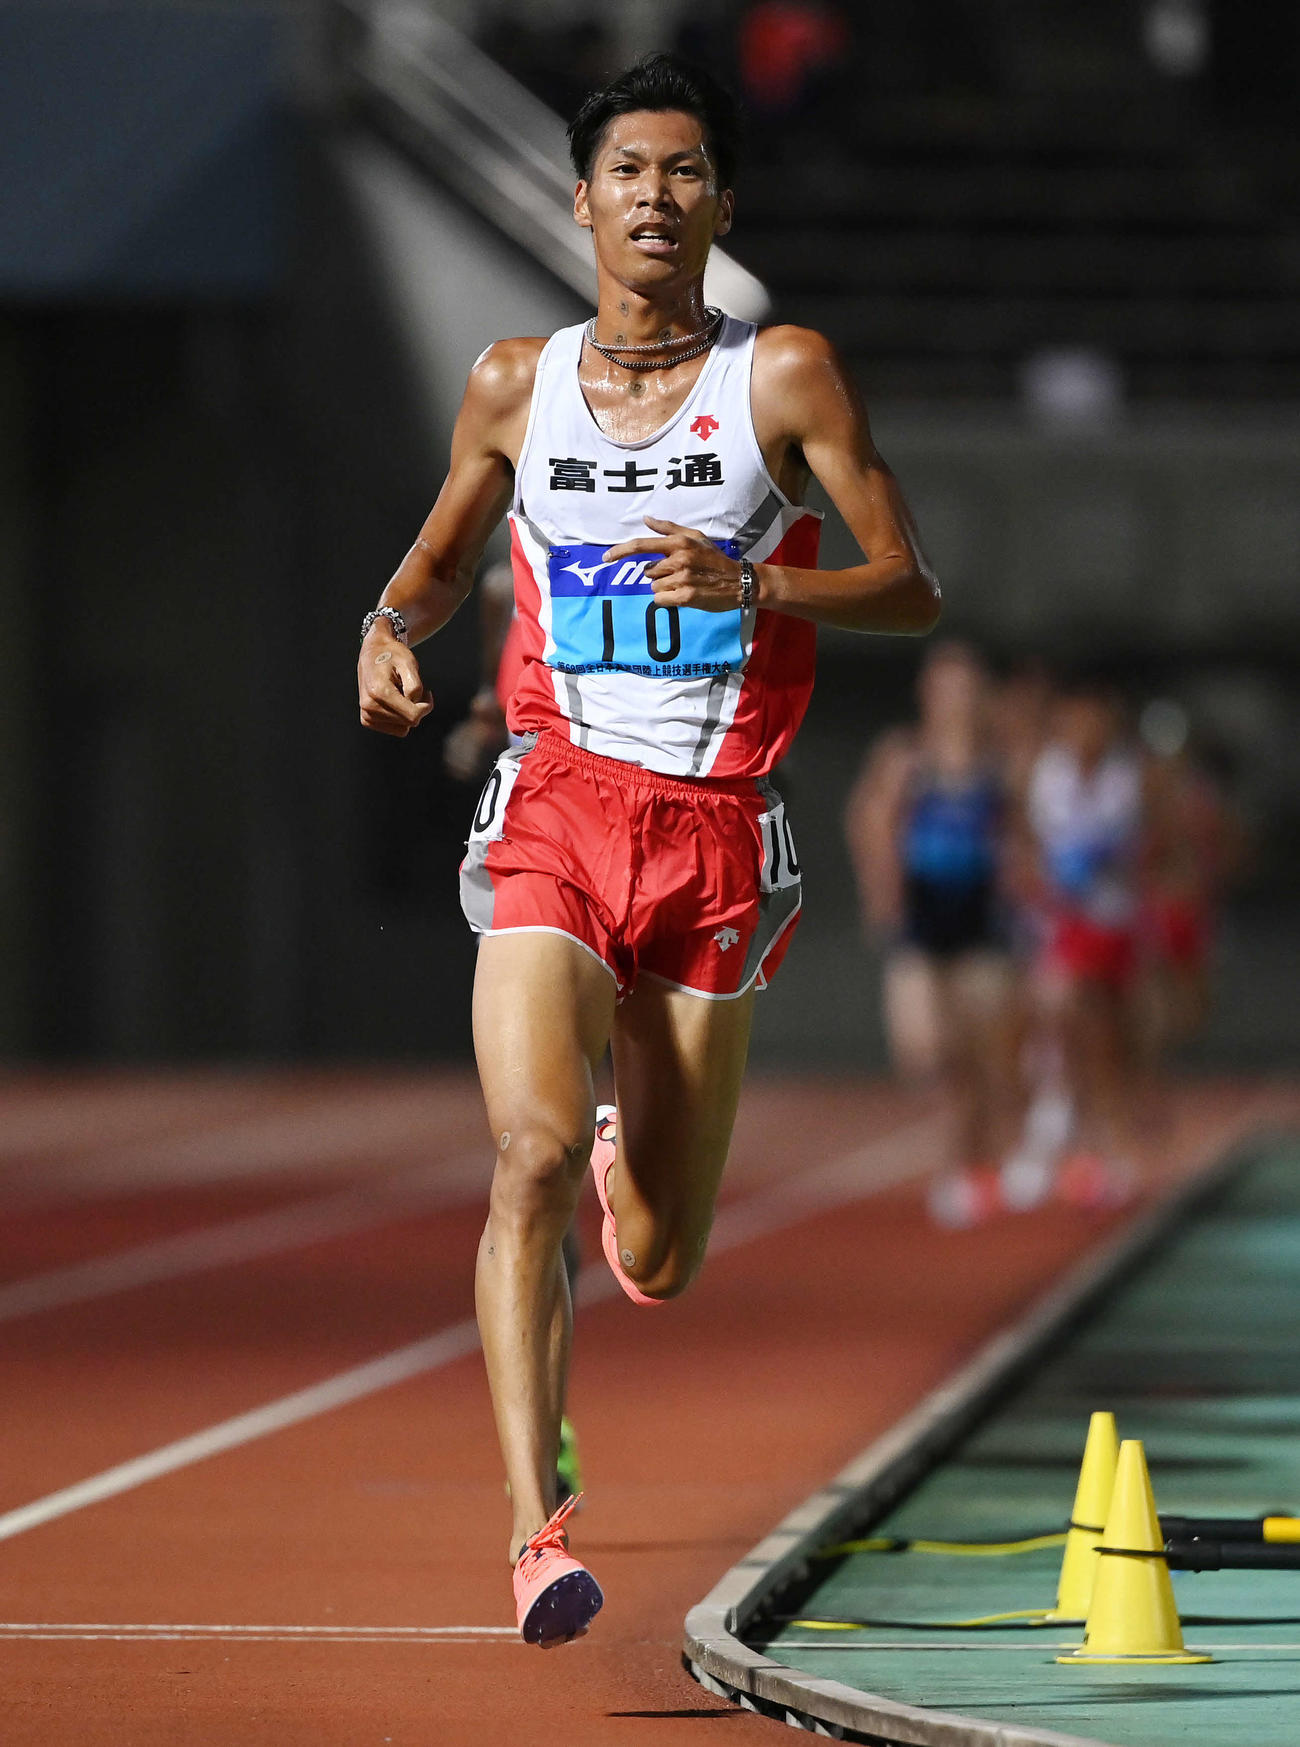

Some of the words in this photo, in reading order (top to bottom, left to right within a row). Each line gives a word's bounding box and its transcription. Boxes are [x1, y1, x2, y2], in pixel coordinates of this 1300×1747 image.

[548, 452, 725, 493] 富士通
[601, 600, 681, 663] 10
